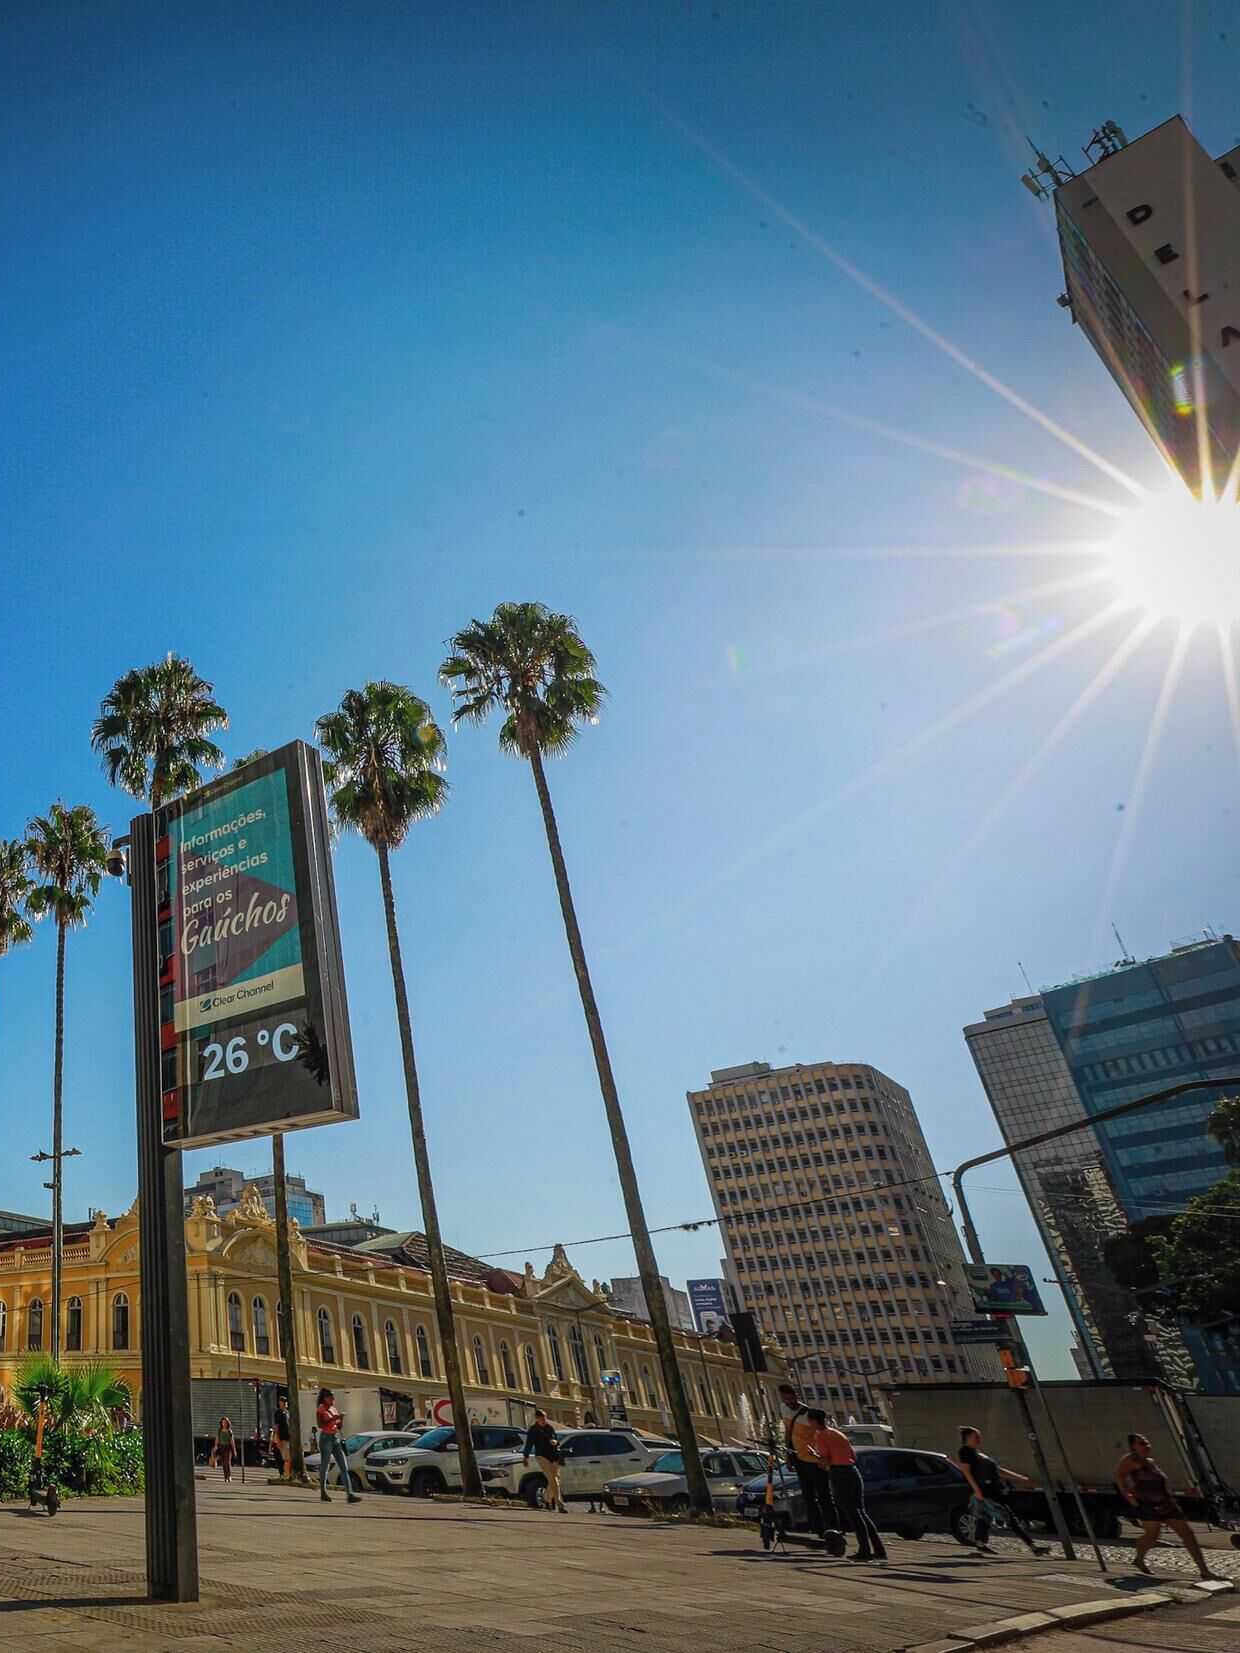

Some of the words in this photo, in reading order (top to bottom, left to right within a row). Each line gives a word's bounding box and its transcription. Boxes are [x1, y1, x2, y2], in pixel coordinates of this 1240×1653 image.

[180, 808, 267, 853] Informações,
[181, 843, 235, 874] serviços
[238, 838, 247, 849] e
[181, 851, 268, 896] experiências
[181, 892, 291, 954] Gaúchos
[182, 896, 212, 919] para
[216, 889, 233, 904] os
[212, 994, 236, 1007] Clear
[236, 981, 275, 1000] Channel
[203, 1036, 249, 1080] 26
